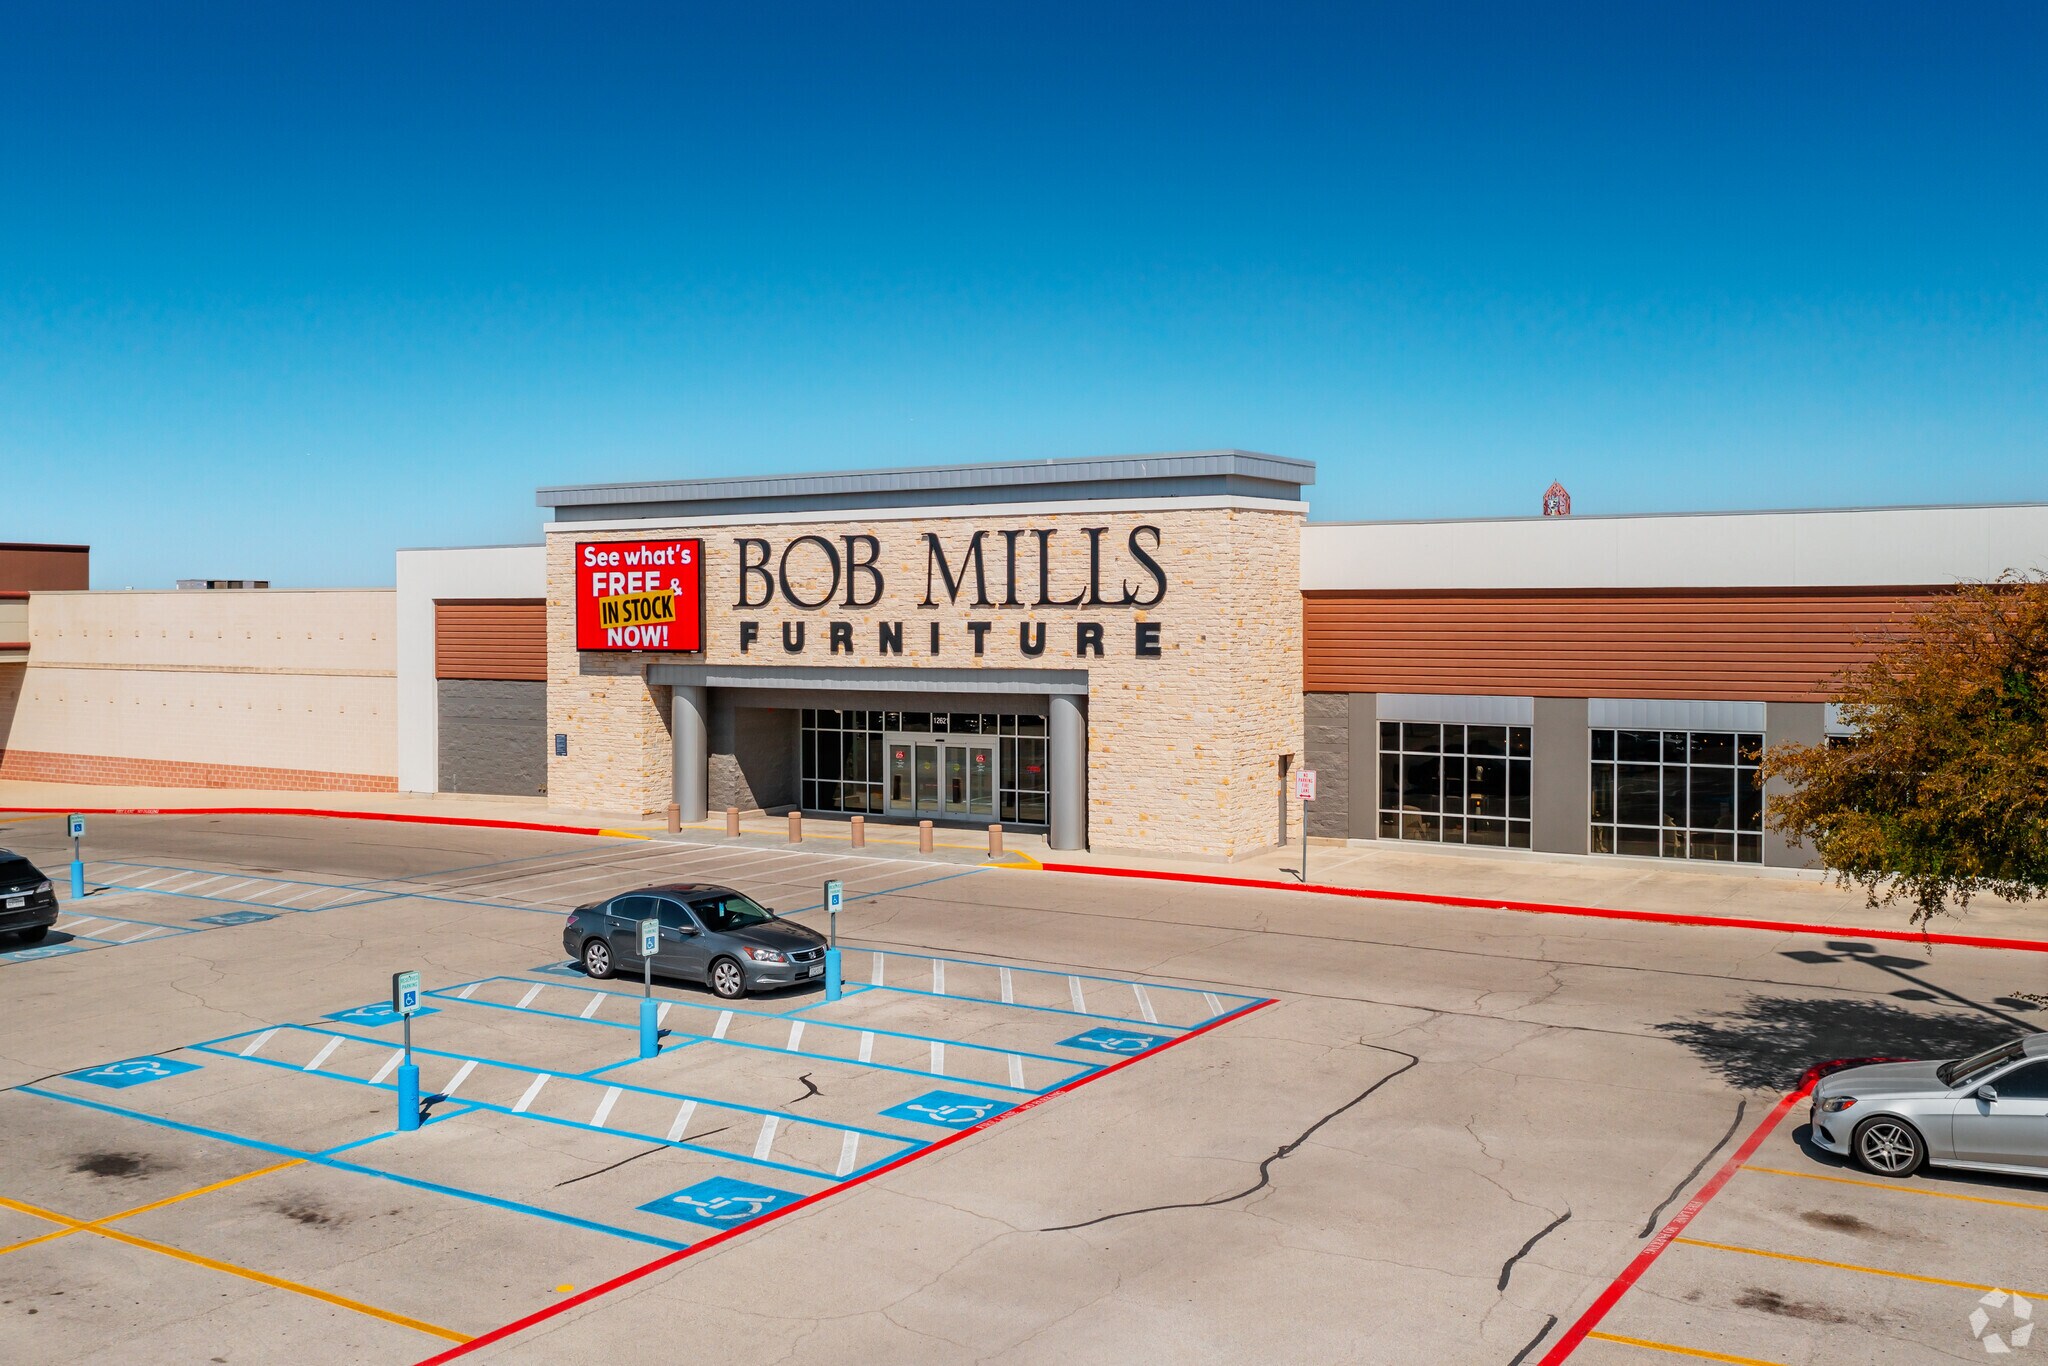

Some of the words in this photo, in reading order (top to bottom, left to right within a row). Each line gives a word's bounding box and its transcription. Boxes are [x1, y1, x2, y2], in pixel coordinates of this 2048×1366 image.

[584, 546, 620, 567] See
[624, 544, 692, 566] what's
[733, 534, 885, 609] BOB
[917, 525, 1168, 609] MILLS
[592, 571, 660, 597] FREE
[669, 578, 683, 596] &
[602, 601, 619, 624] IN
[622, 595, 673, 622] STOCK
[607, 626, 668, 647] NOW!
[740, 621, 1162, 657] FURNITURE
